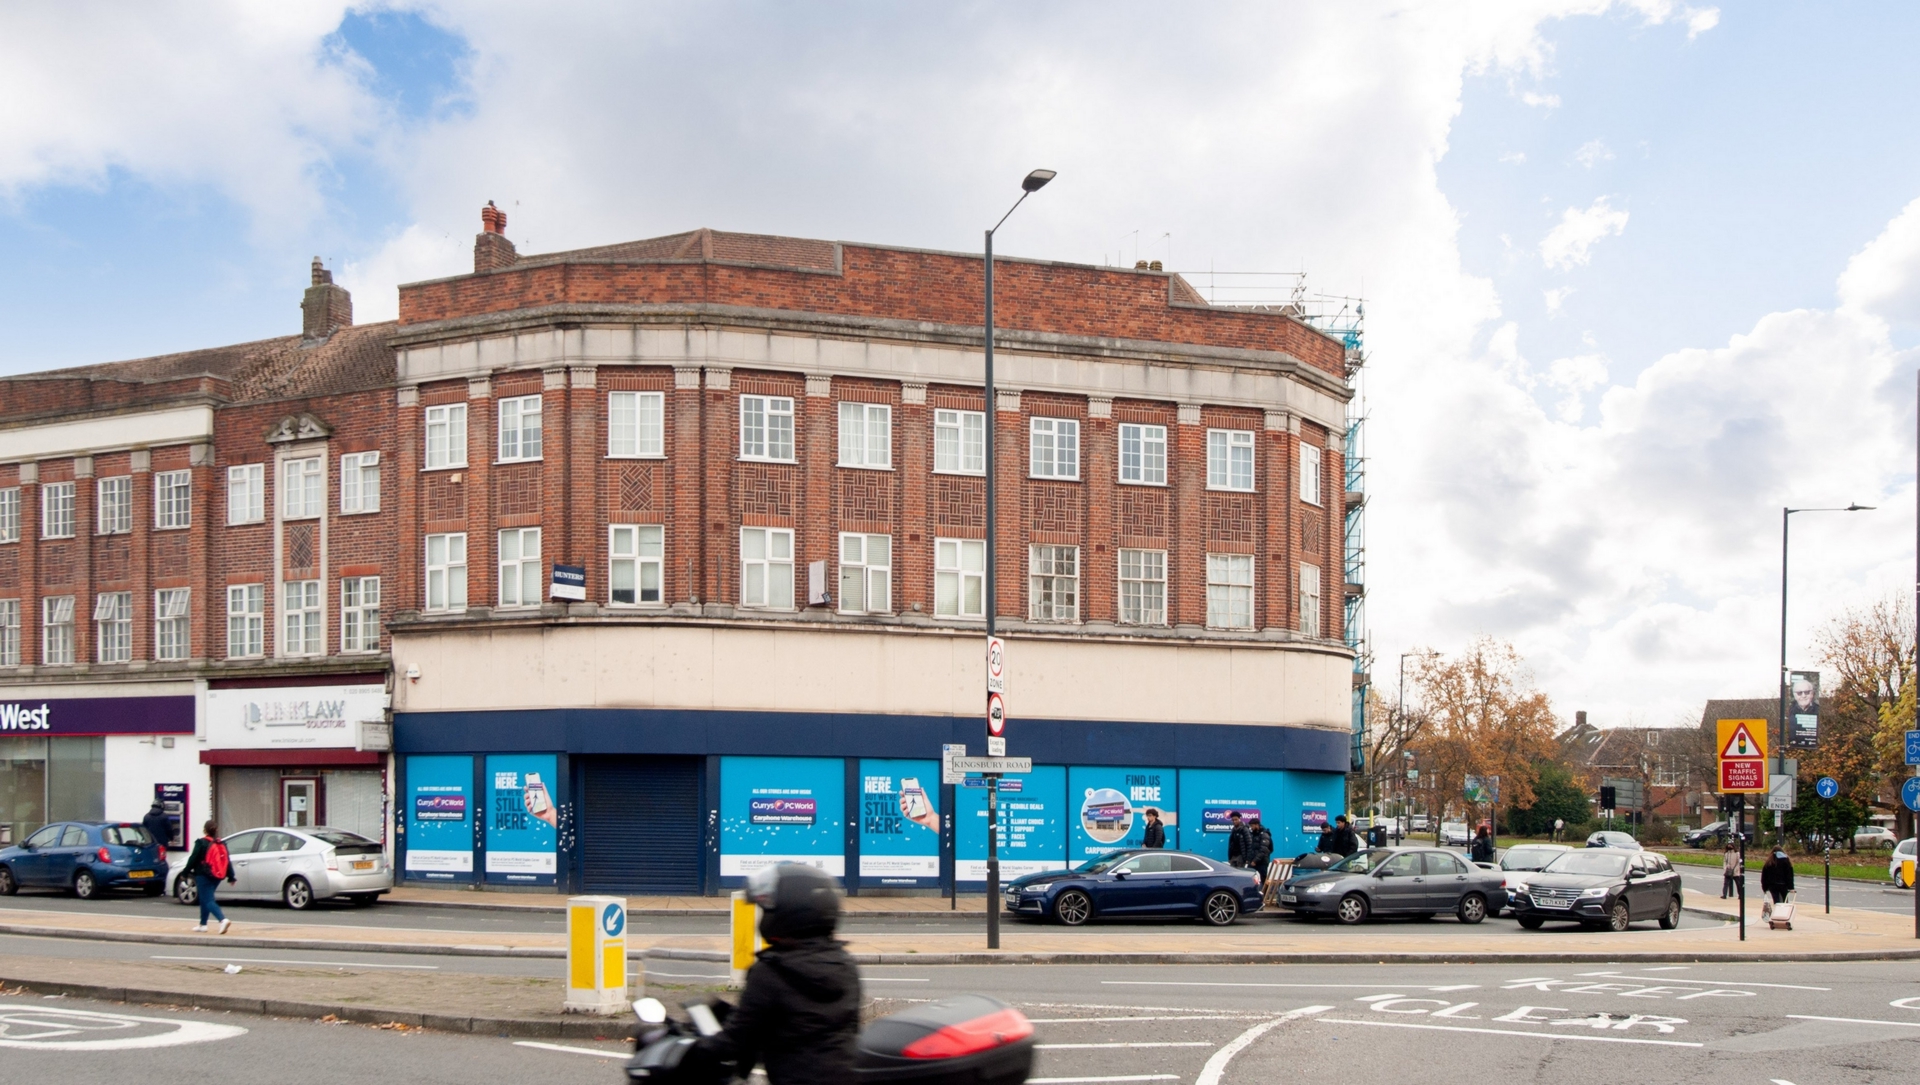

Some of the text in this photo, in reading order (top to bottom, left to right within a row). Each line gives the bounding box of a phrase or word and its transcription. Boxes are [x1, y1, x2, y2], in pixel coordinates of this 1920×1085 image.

[554, 570, 584, 581] HUNTERS
[992, 651, 1001, 666] 20
[989, 678, 1003, 690] ZONE
[0, 703, 50, 730] West
[264, 700, 345, 722] LINKLAW
[306, 719, 346, 729] SOLICITORS
[954, 761, 1031, 769] KINGSBURY ROAD
[1126, 775, 1160, 786] FIND US
[1130, 786, 1161, 801] HERE
[417, 799, 434, 807] Currys
[495, 798, 523, 812] STILL
[752, 801, 774, 810] Currys
[865, 802, 898, 816] STILL
[495, 813, 527, 830] HERE
[865, 817, 903, 834] HERE
[1500, 977, 1757, 1000] KEEP
[1369, 999, 1688, 1033] CLEAR
